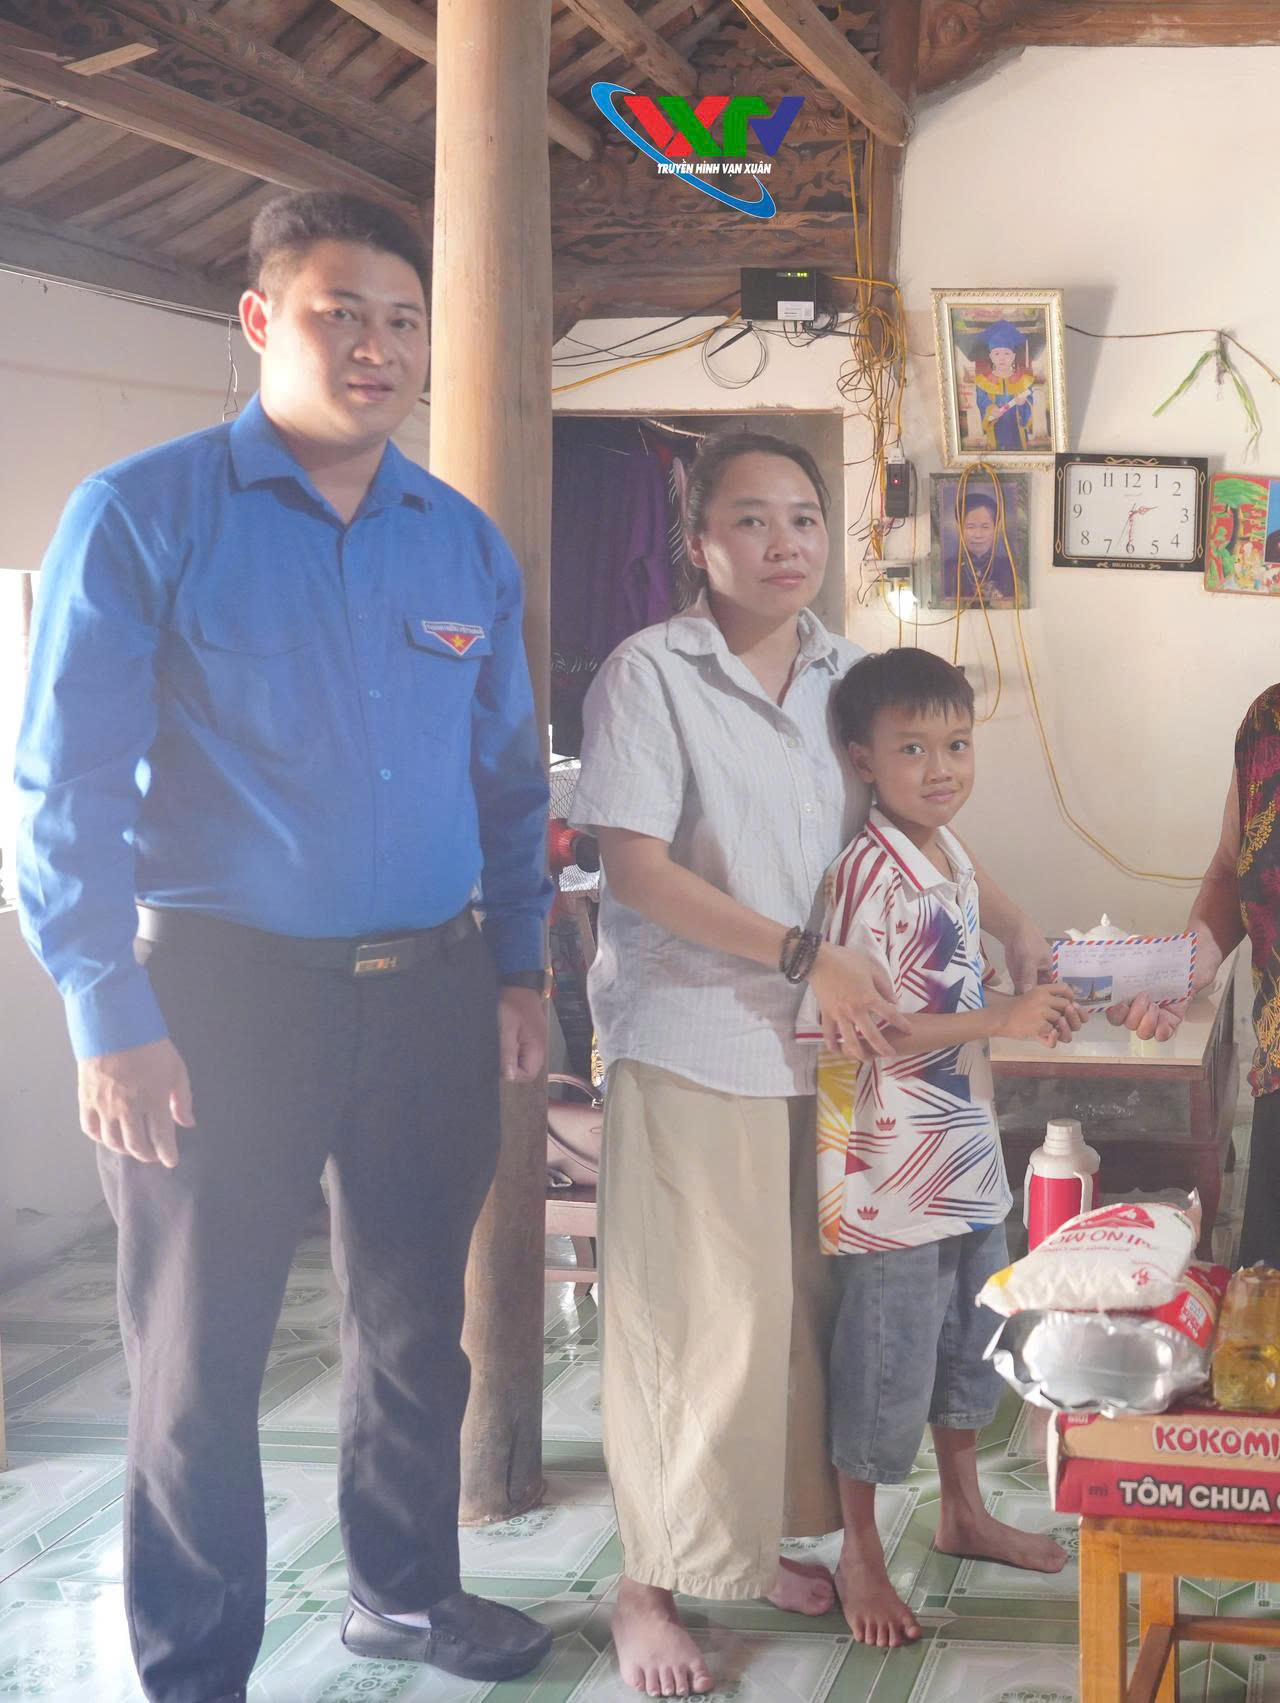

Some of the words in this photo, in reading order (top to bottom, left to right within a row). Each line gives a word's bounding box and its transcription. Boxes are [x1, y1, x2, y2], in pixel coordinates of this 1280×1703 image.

[1078, 480, 1092, 495] 10
[1103, 473, 1113, 487] 11
[1124, 473, 1141, 488] 12
[1154, 474, 1158, 488] 1
[1172, 481, 1181, 496] 2
[1073, 504, 1082, 519] 9
[1180, 508, 1189, 523] 3
[1081, 530, 1090, 545] 8
[1170, 533, 1180, 548] 4
[1103, 539, 1112, 554] 7
[1126, 540, 1135, 554] 6
[1150, 540, 1159, 555] 5
[1118, 1476, 1184, 1507] TÔM
[1189, 1487, 1271, 1513] CHUA
